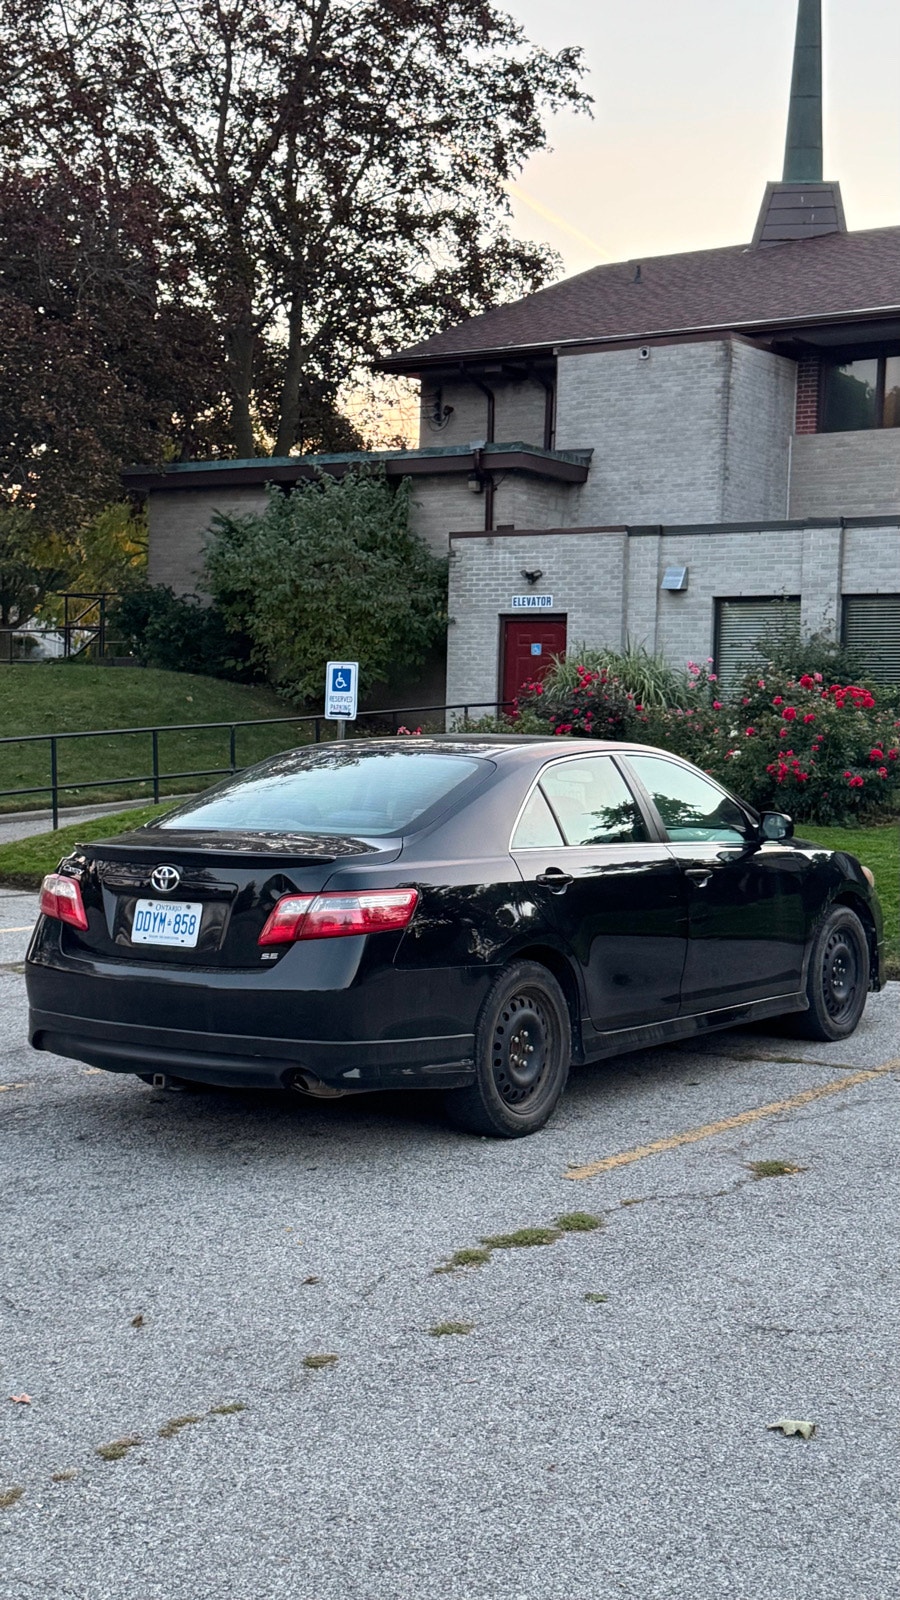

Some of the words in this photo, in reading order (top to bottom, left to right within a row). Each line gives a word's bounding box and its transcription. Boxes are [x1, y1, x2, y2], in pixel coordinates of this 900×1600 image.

[513, 597, 551, 606] ELEVATOR
[329, 695, 353, 703] RESERVED
[173, 914, 197, 935] 858
